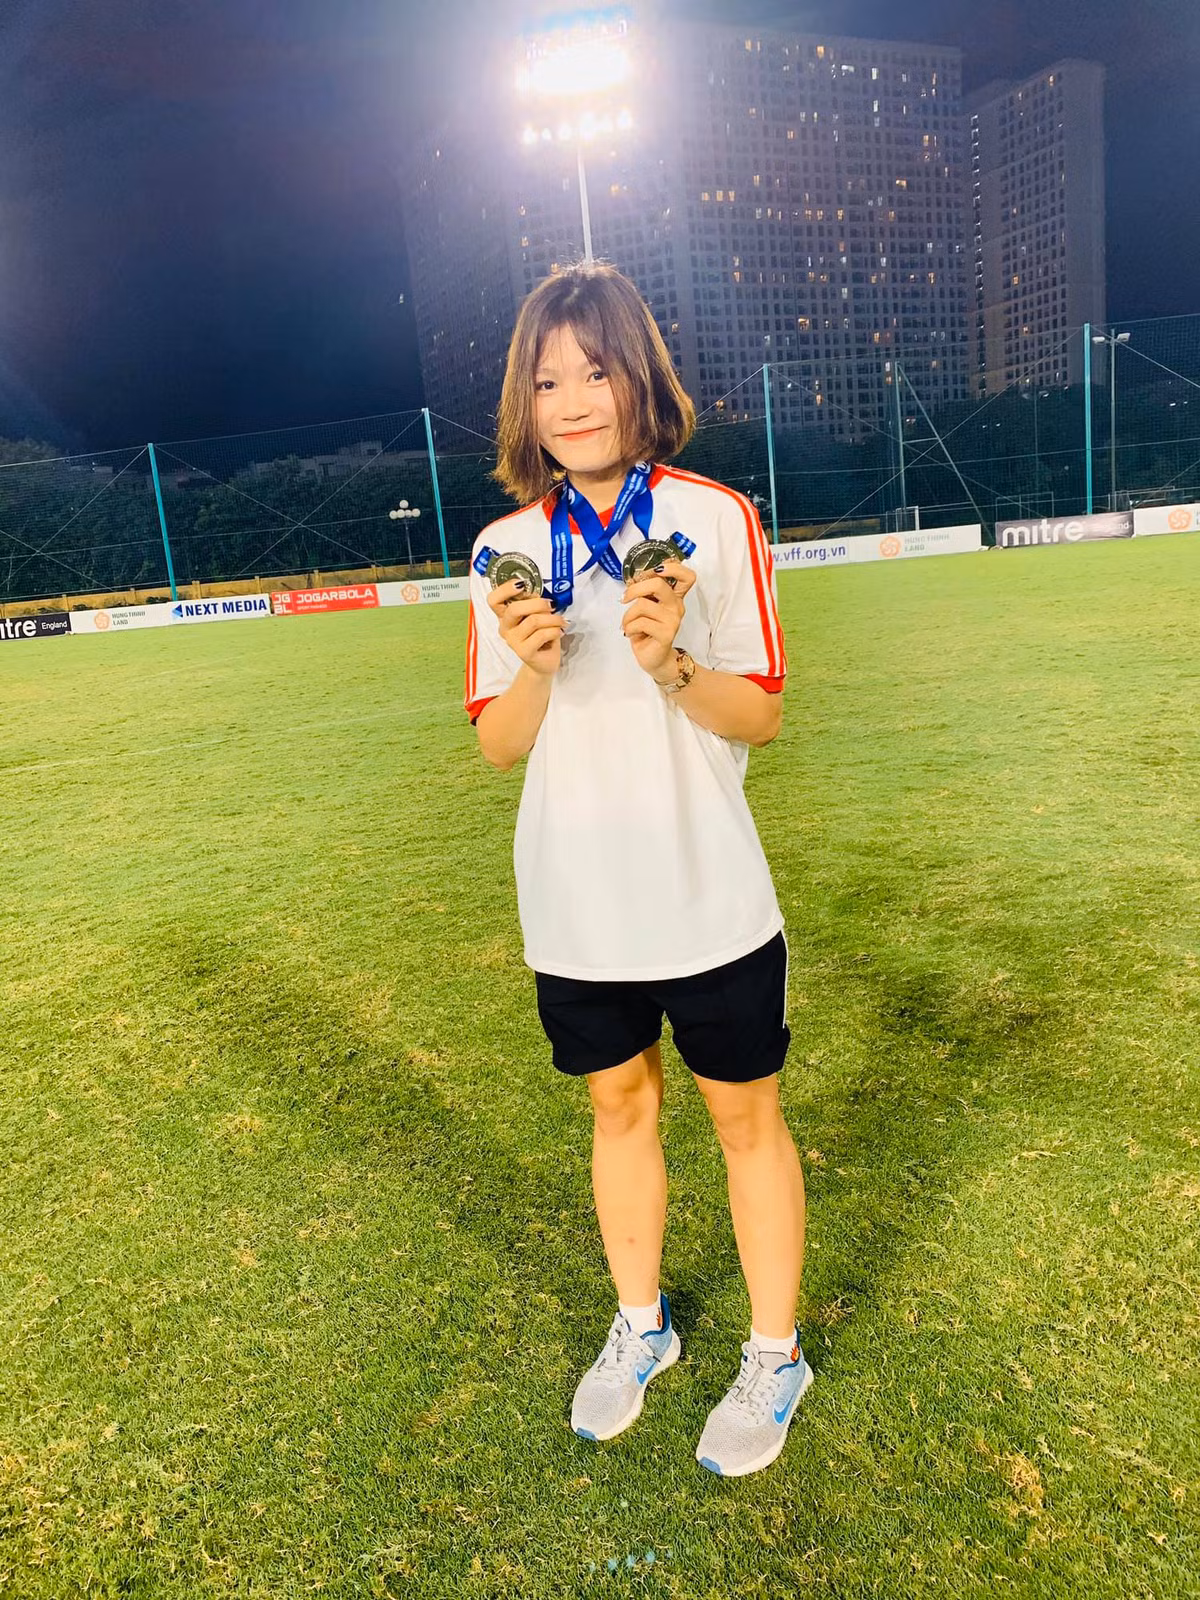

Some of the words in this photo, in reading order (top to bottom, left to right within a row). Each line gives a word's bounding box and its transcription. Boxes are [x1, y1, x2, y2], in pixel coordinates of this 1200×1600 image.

[1002, 519, 1085, 547] mitre
[904, 543, 925, 552] LAND
[274, 593, 291, 605] JG
[296, 588, 374, 604] JOGARBOLA
[422, 591, 441, 599] LAND
[185, 602, 219, 617] NEXT
[222, 599, 268, 614] MEDIA
[274, 603, 293, 615] BL
[112, 618, 129, 626] LAND
[0, 618, 37, 639] itre
[41, 620, 68, 631] England
